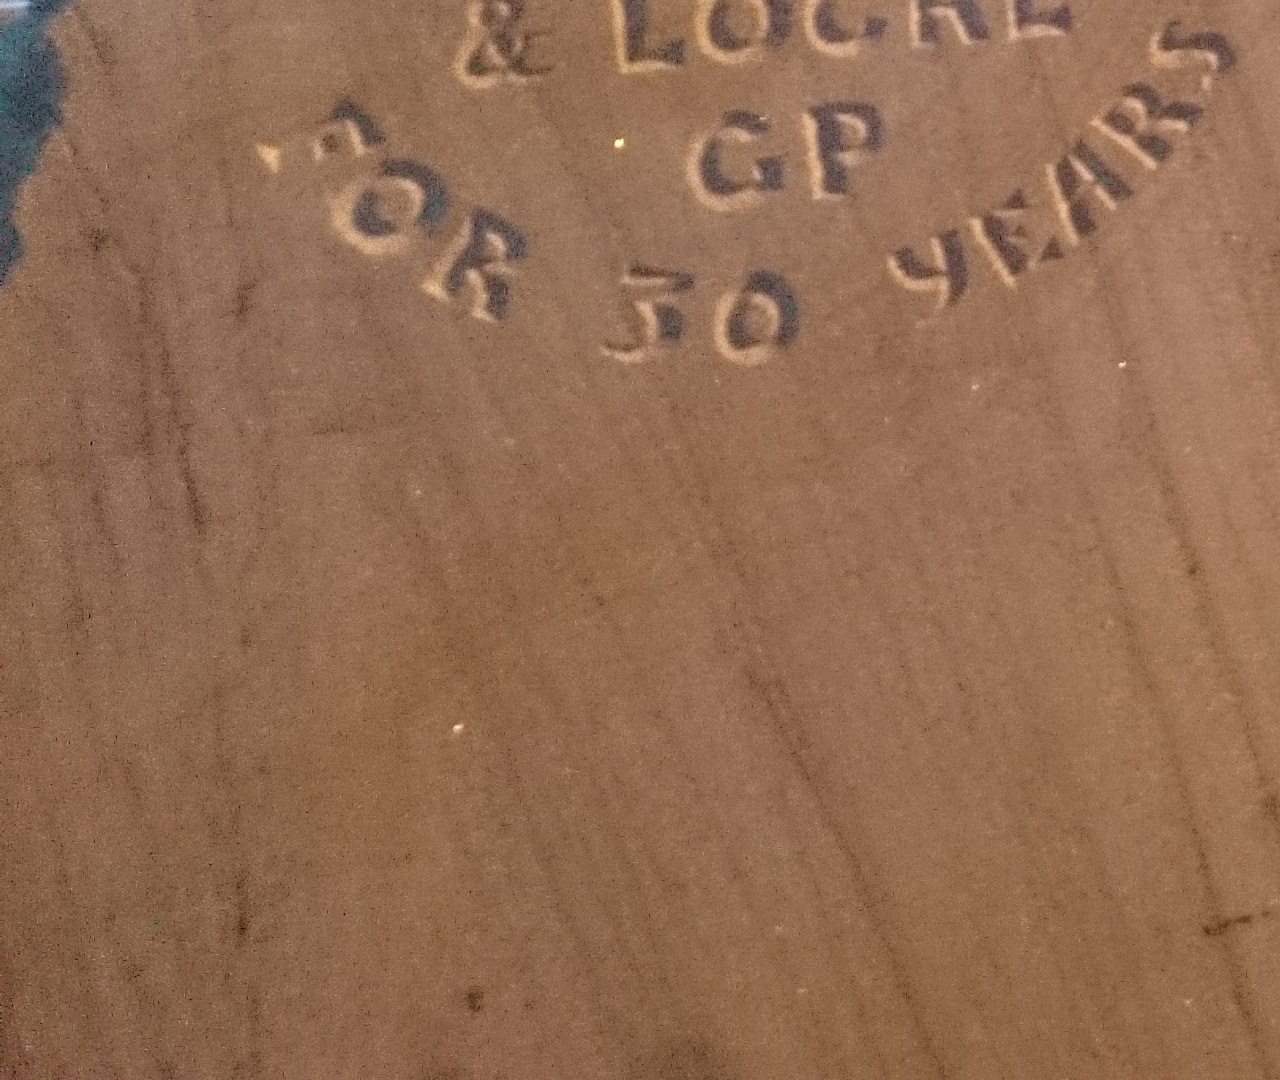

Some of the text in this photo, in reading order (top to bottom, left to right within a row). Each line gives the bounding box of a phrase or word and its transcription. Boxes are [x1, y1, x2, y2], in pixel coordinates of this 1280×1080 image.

[256, 20, 1240, 366] FOR 30 YEARS
[686, 101, 886, 213] GP
